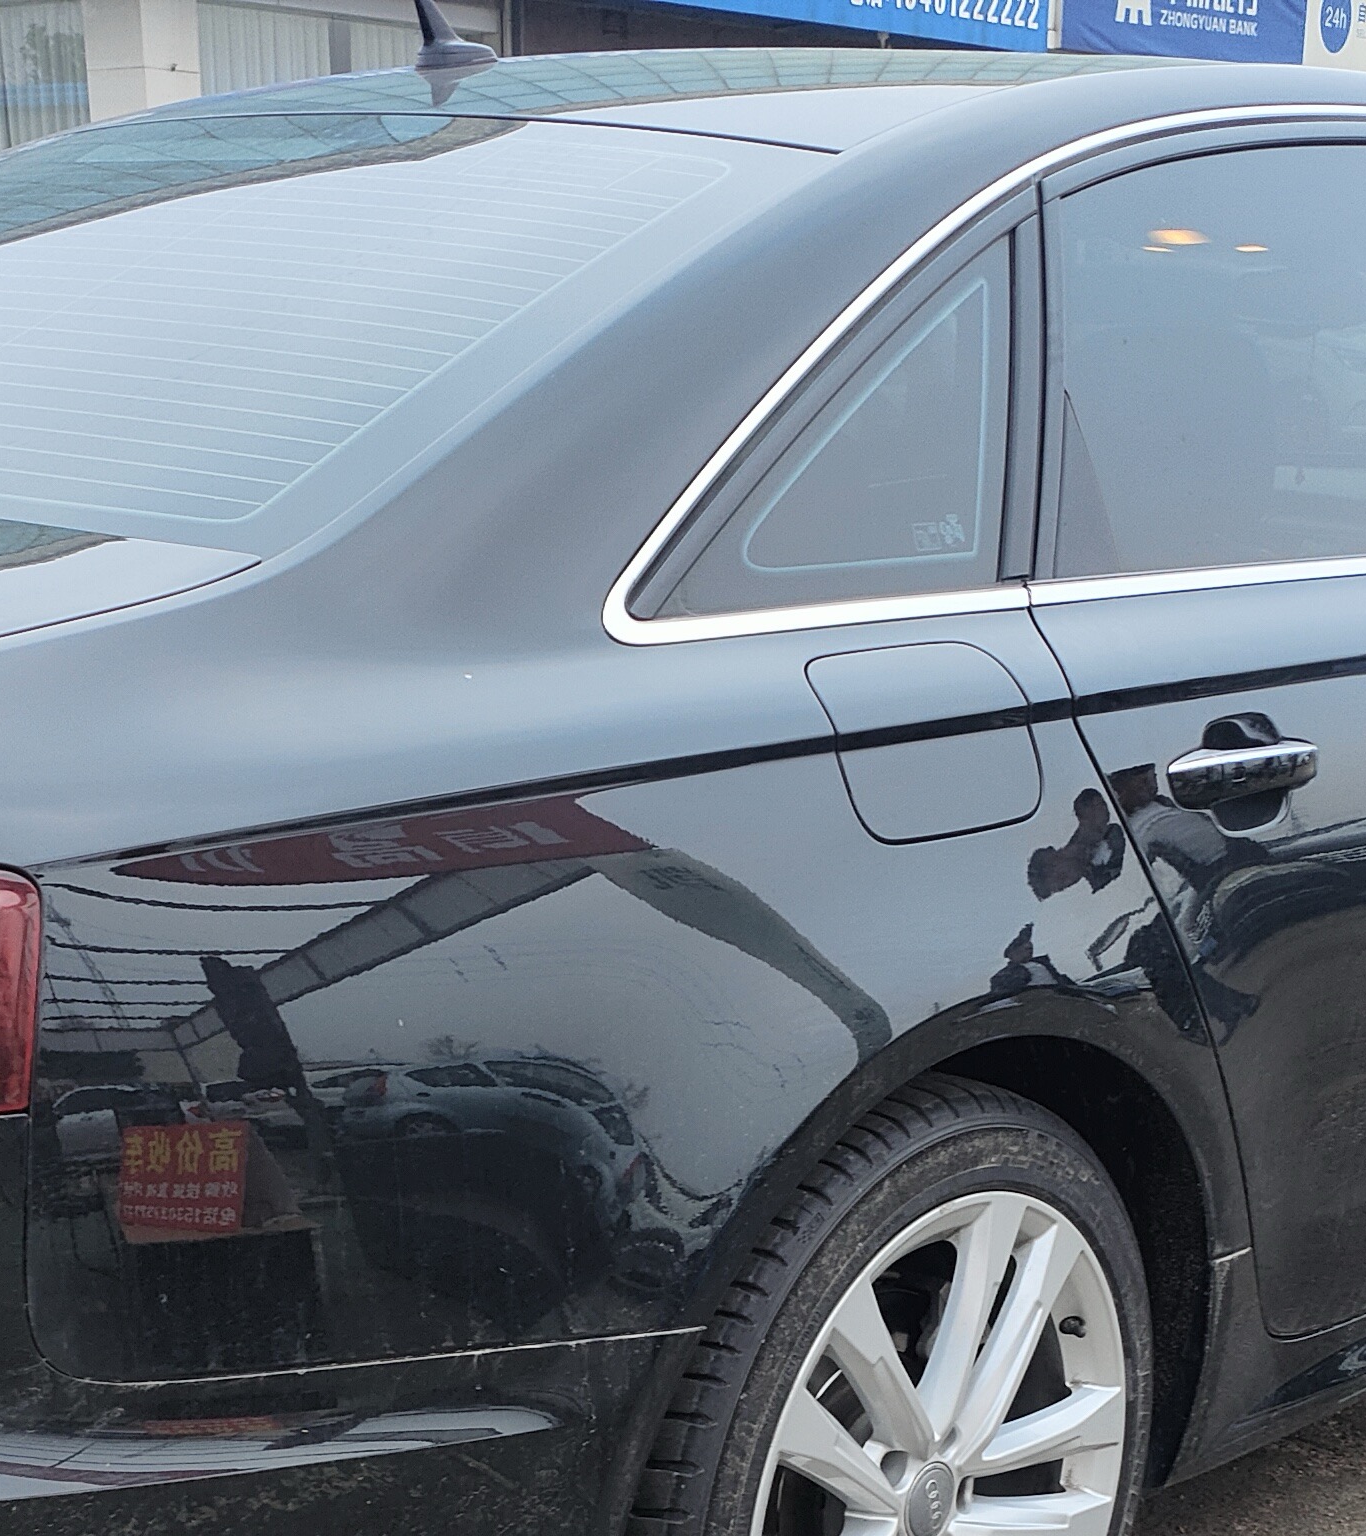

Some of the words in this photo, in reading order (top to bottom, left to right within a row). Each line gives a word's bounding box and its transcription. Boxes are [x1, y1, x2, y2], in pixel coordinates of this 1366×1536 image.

[1160, 9, 1227, 33] ZHONGYUAN
[1229, 19, 1258, 37] BANK
[1324, 5, 1347, 30] 24h
